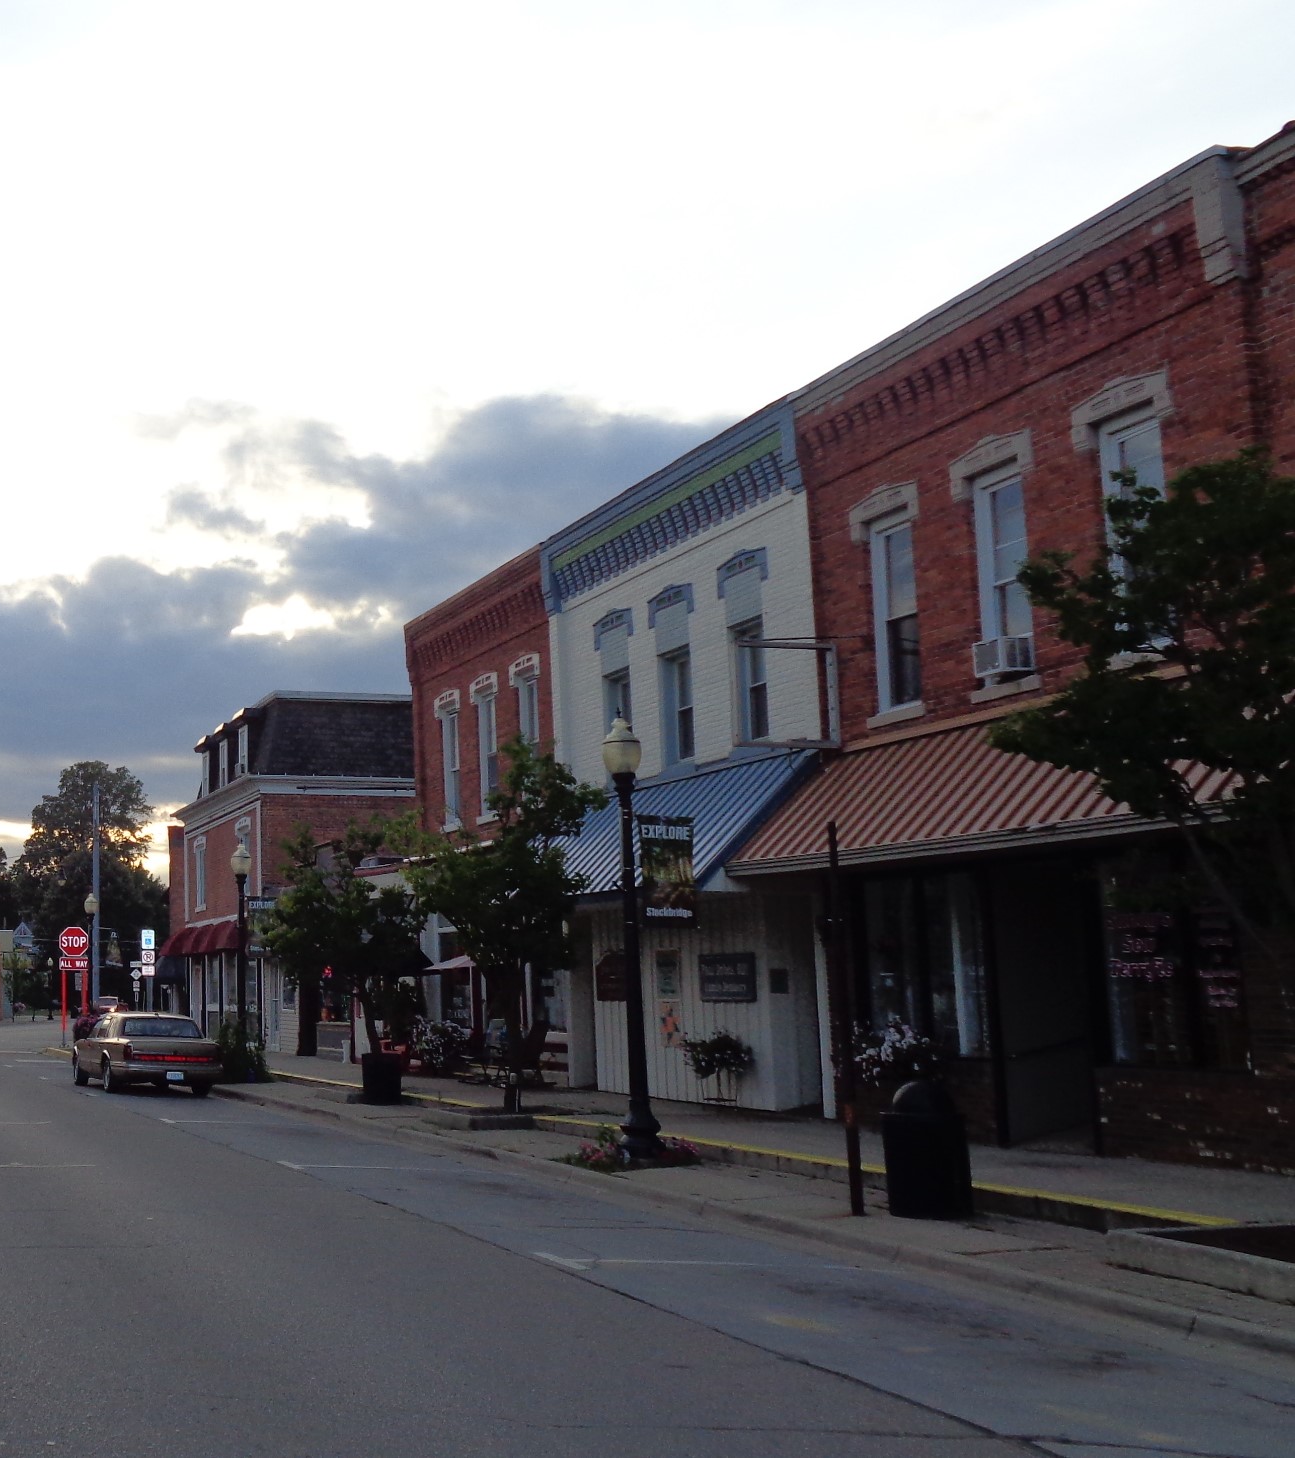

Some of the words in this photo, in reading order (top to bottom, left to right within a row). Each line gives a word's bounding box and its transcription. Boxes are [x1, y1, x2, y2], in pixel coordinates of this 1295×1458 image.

[641, 824, 691, 840] EXPLORE
[248, 900, 276, 909] EXPLORE
[646, 907, 693, 918] Stockbridge
[61, 936, 87, 948] STOP
[60, 960, 72, 968] ALL
[75, 960, 88, 968] WAY
